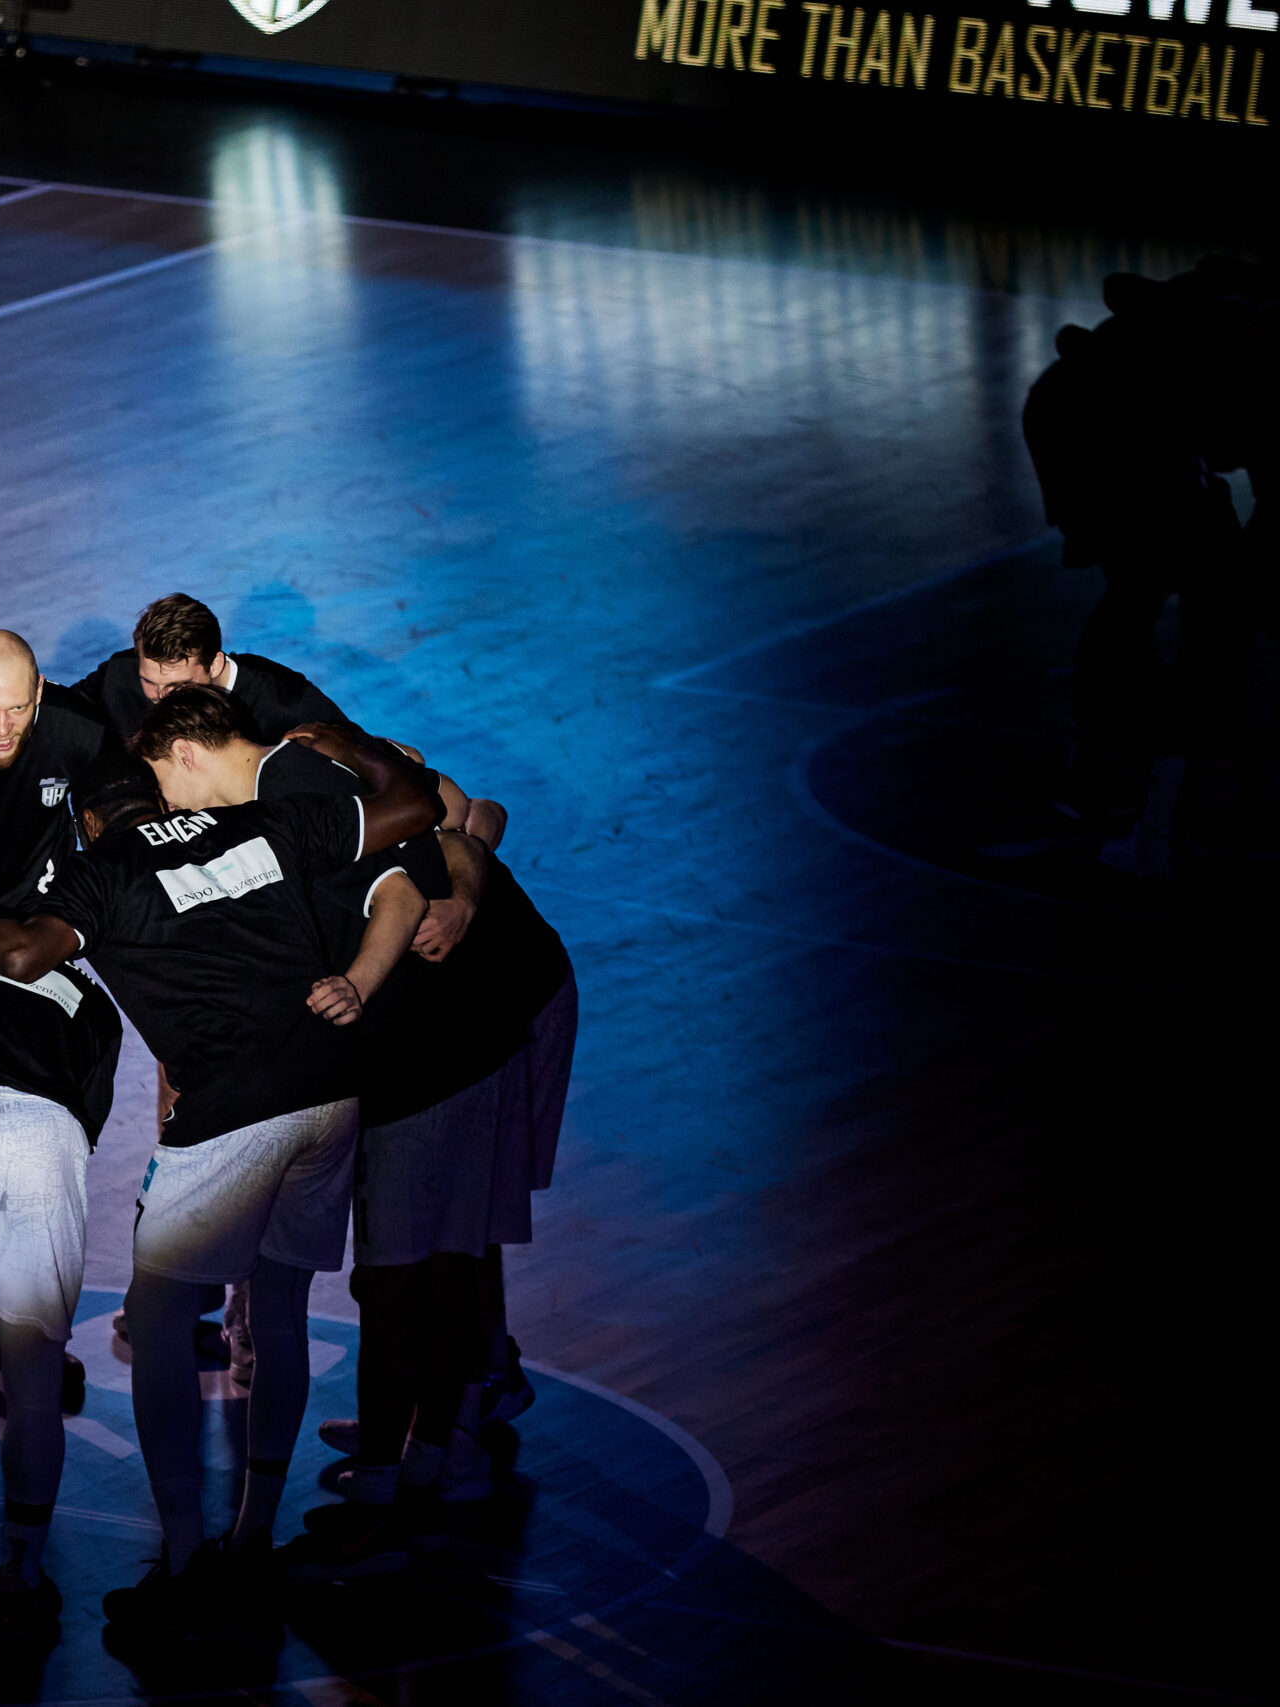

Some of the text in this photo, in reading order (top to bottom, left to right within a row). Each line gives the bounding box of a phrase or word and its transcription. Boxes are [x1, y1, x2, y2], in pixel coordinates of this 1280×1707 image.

[635, 0, 1270, 126] MORE THAN BASKETBALL
[176, 886, 214, 906] ENDO
